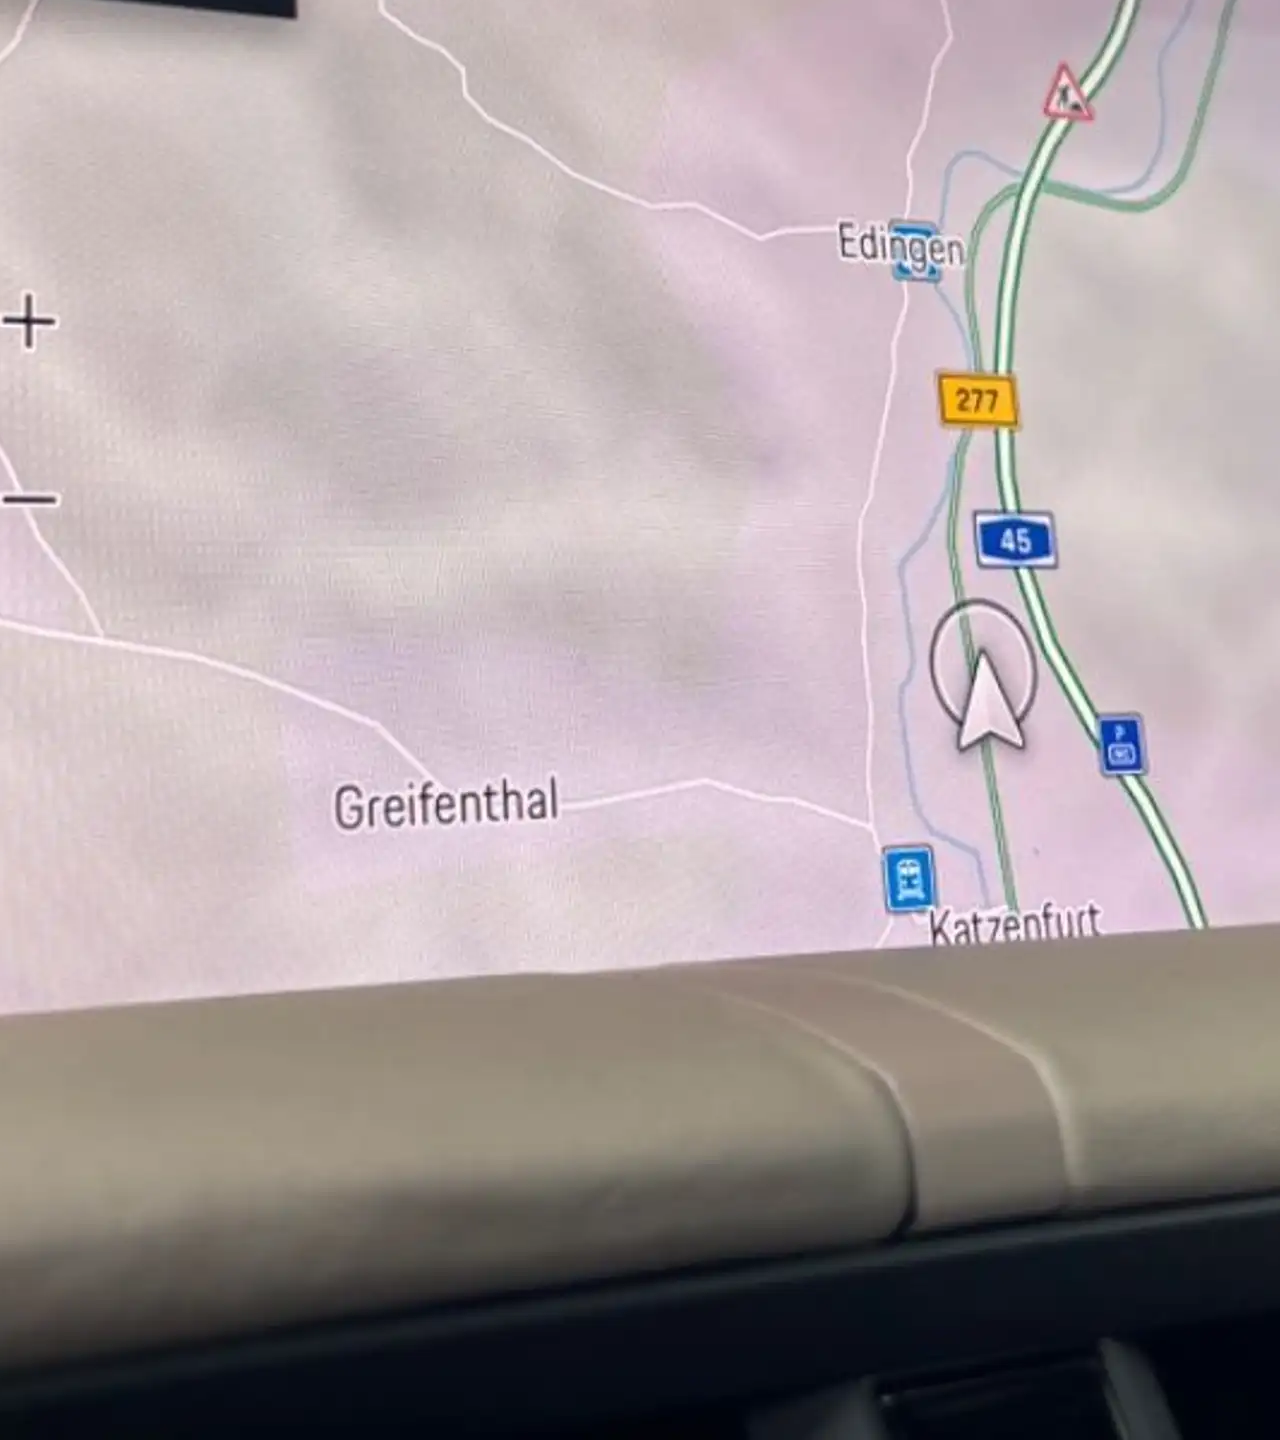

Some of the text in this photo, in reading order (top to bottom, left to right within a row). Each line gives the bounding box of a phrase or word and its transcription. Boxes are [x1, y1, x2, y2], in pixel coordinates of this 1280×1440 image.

[838, 221, 965, 273] Edingen
[955, 387, 999, 414] 277
[999, 527, 1033, 554] 45
[334, 775, 559, 831] Greifenthal
[928, 901, 1102, 947] Katzenfurt
